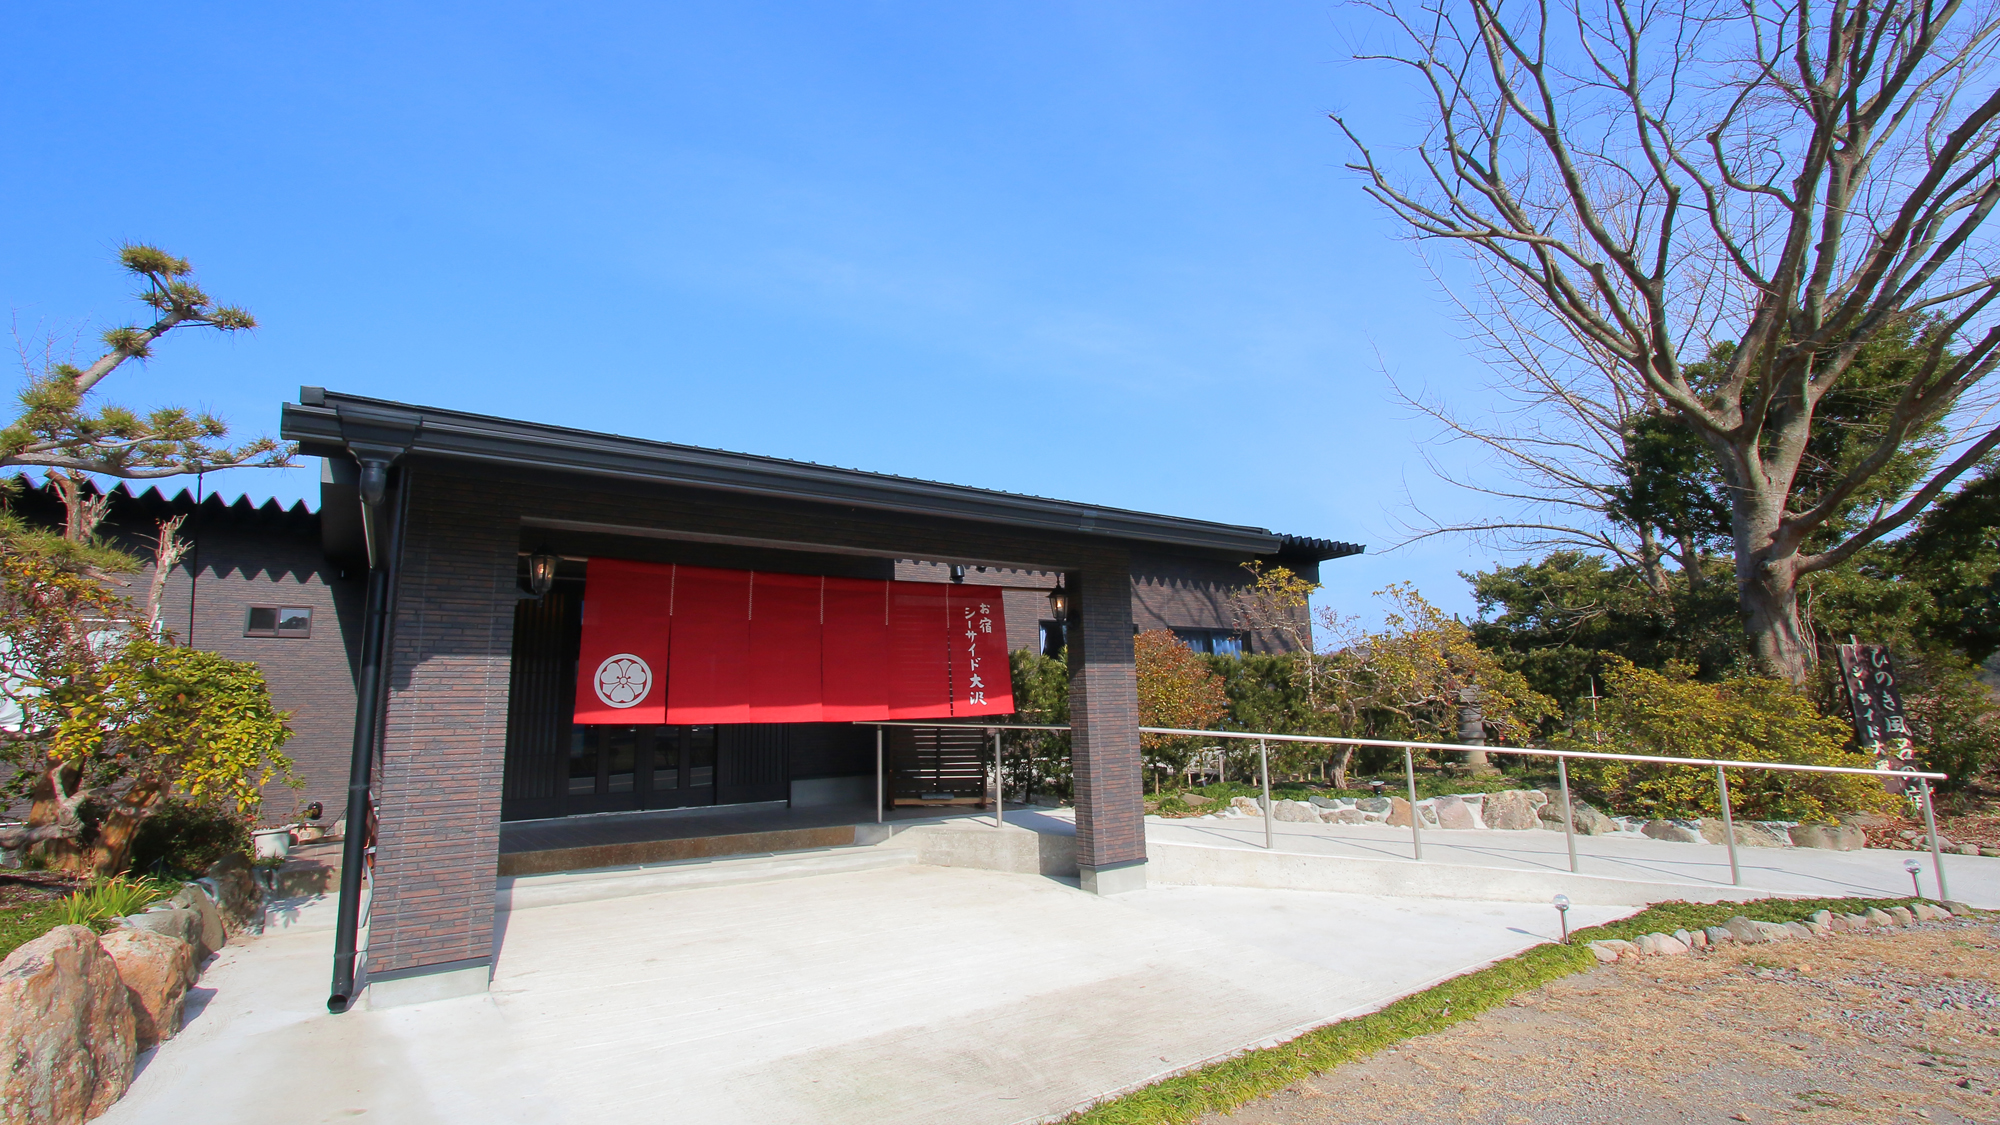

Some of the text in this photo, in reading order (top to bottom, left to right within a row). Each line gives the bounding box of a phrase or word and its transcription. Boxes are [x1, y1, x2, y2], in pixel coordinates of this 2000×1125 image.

[979, 603, 992, 633] お宿
[965, 607, 987, 705] シーサイド大沢
